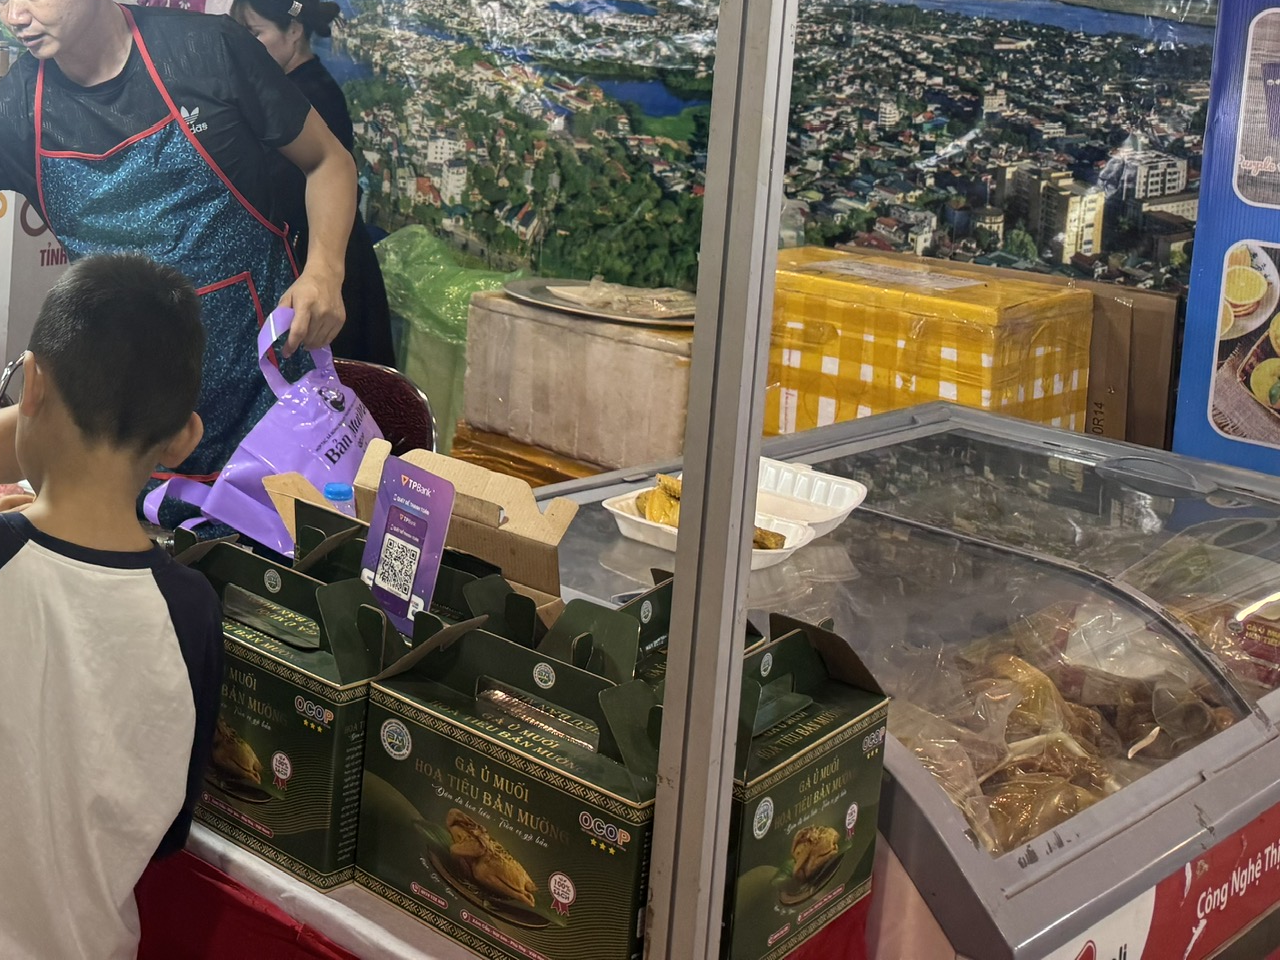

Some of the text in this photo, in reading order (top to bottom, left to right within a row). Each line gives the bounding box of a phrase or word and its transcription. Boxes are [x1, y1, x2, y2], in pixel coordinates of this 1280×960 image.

[323, 433, 353, 465] Bản
[408, 478, 432, 498] TPBank
[229, 666, 257, 691] MUỐI
[294, 695, 334, 724] OCOP
[463, 713, 499, 733] TIÊU
[497, 729, 533, 749] BẢN
[520, 728, 560, 749] MUỐI
[455, 755, 529, 804] GÀ Ủ MUỐI
[799, 775, 811, 793] GÀ
[820, 755, 840, 778] MUỐI
[414, 758, 569, 844] HOA TIÊU BẢN MƯỜNG
[813, 781, 832, 802] BẢN
[577, 810, 631, 846] OCOP
[1196, 853, 1262, 919] Công Nghệ
